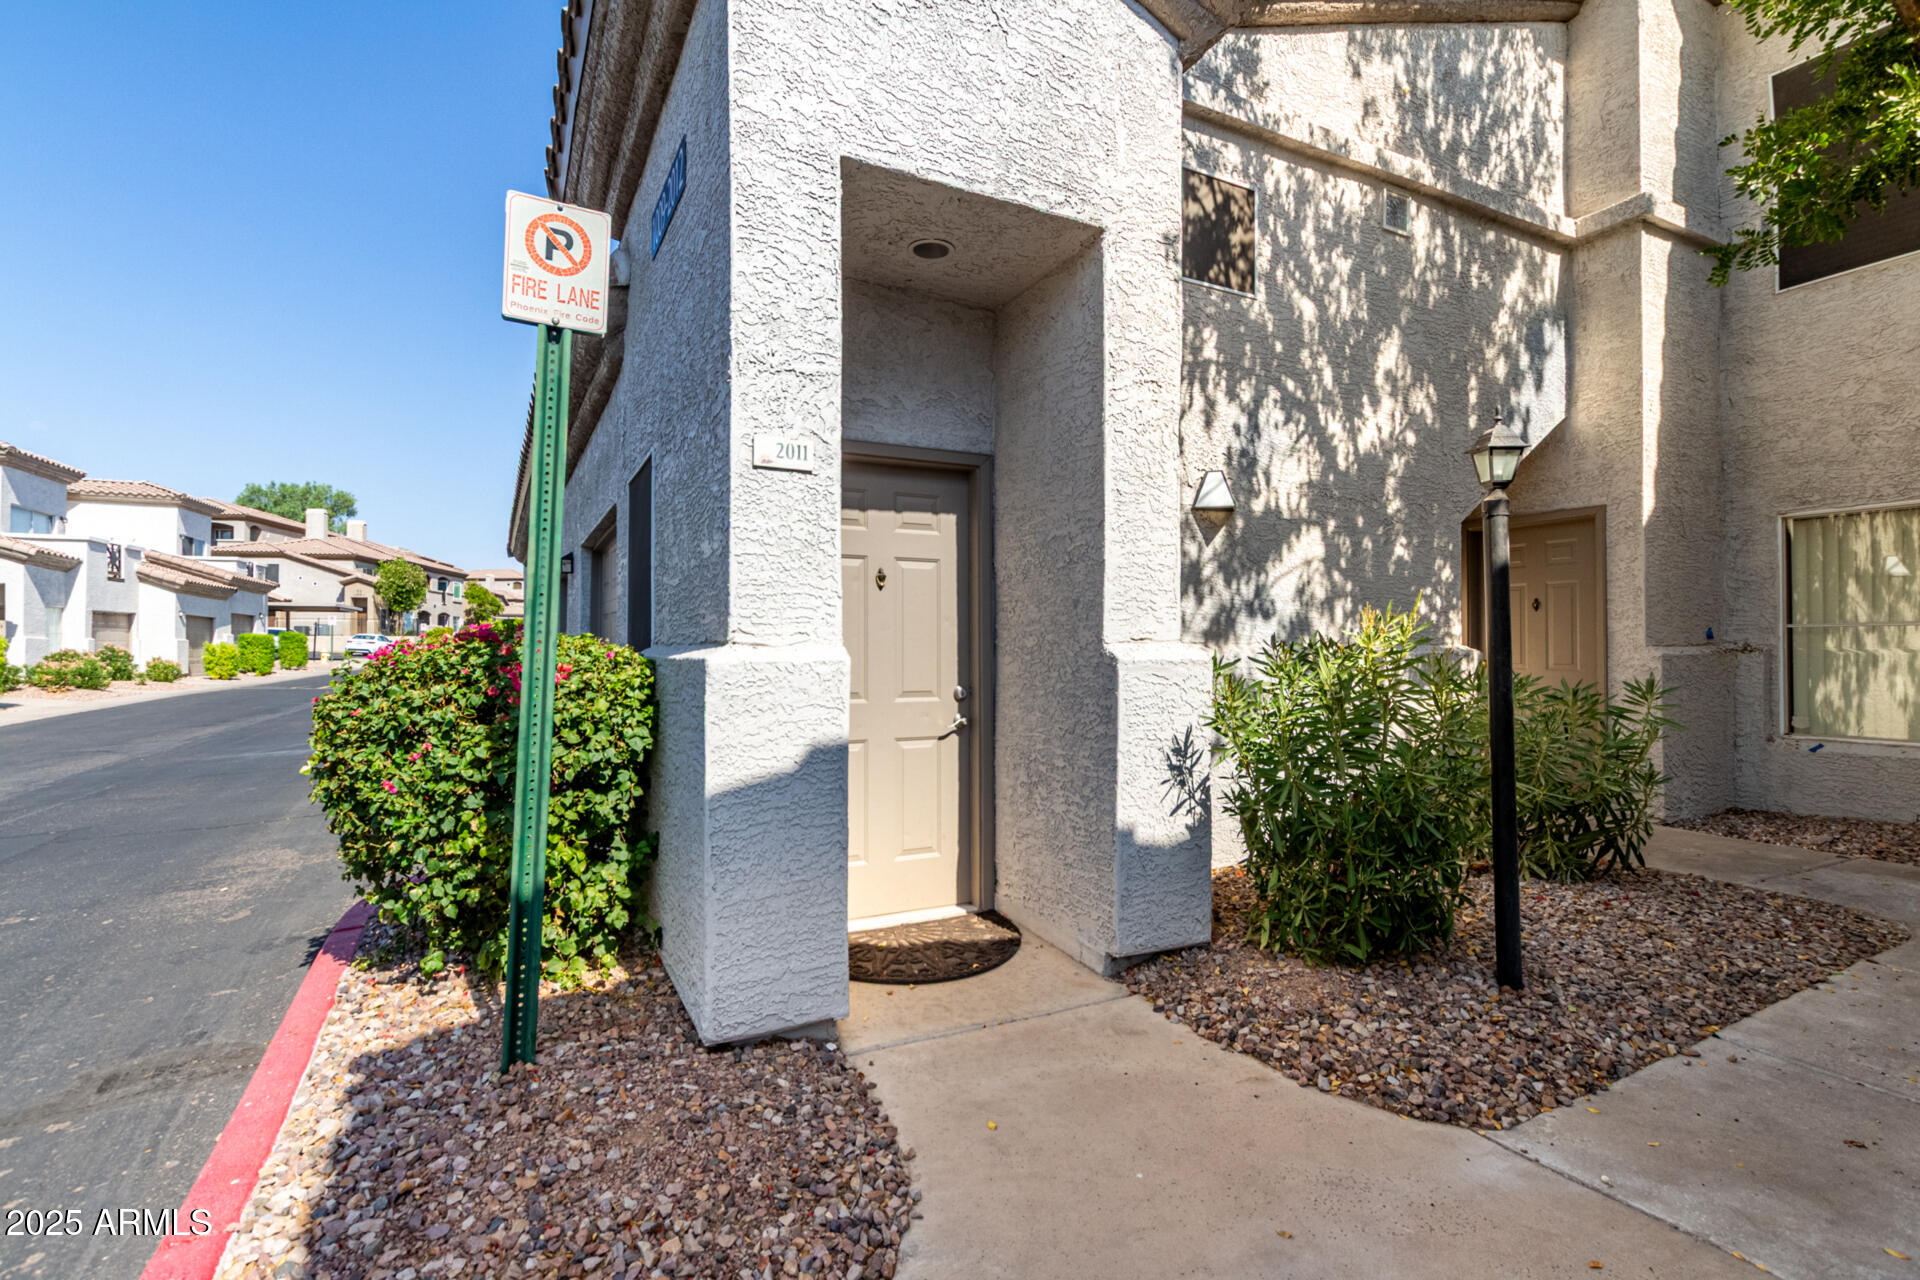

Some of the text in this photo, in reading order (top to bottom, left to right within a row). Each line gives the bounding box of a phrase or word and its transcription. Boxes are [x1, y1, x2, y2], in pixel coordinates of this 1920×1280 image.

[545, 227, 574, 261] P
[511, 273, 600, 310] FIRE LANE
[510, 300, 548, 315] Phoenix
[575, 313, 600, 325] Code
[776, 442, 808, 461] 2011
